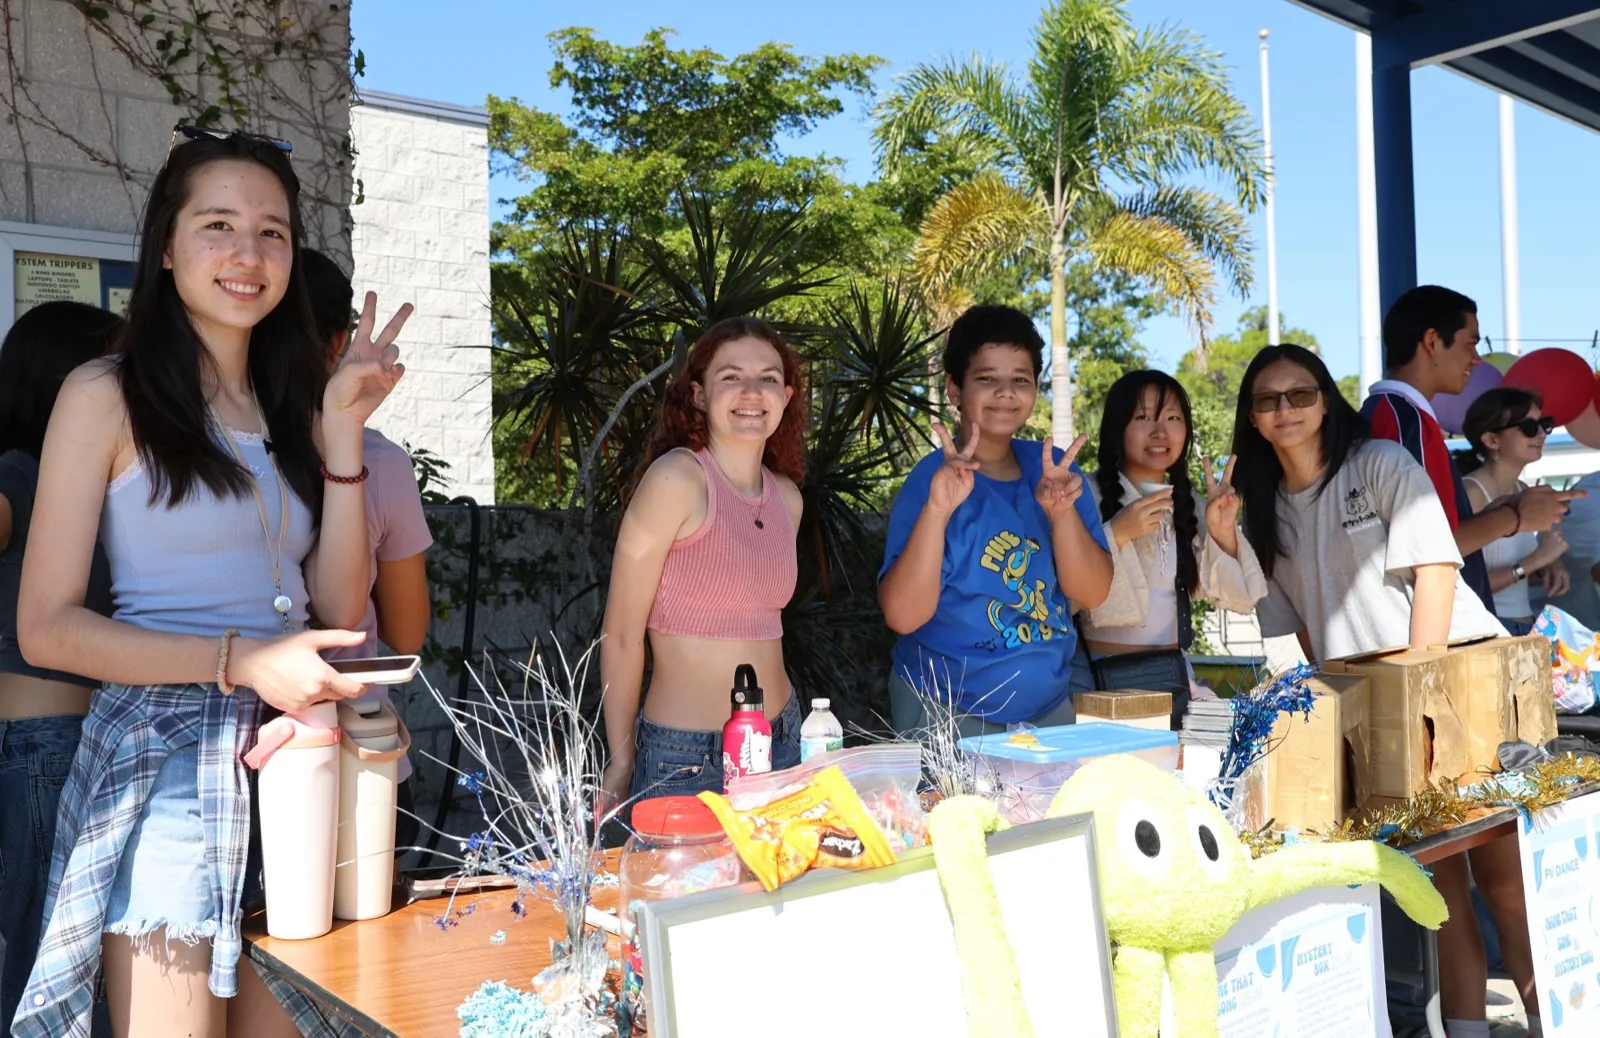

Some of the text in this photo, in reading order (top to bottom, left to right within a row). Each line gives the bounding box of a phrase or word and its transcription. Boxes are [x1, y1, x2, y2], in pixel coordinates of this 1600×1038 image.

[49, 260, 93, 270] TRIPPERS
[1555, 858, 1579, 877] DANCE
[1296, 942, 1332, 967] MYSTERY
[1313, 960, 1330, 976] BOX
[1230, 971, 1254, 993] THAT
